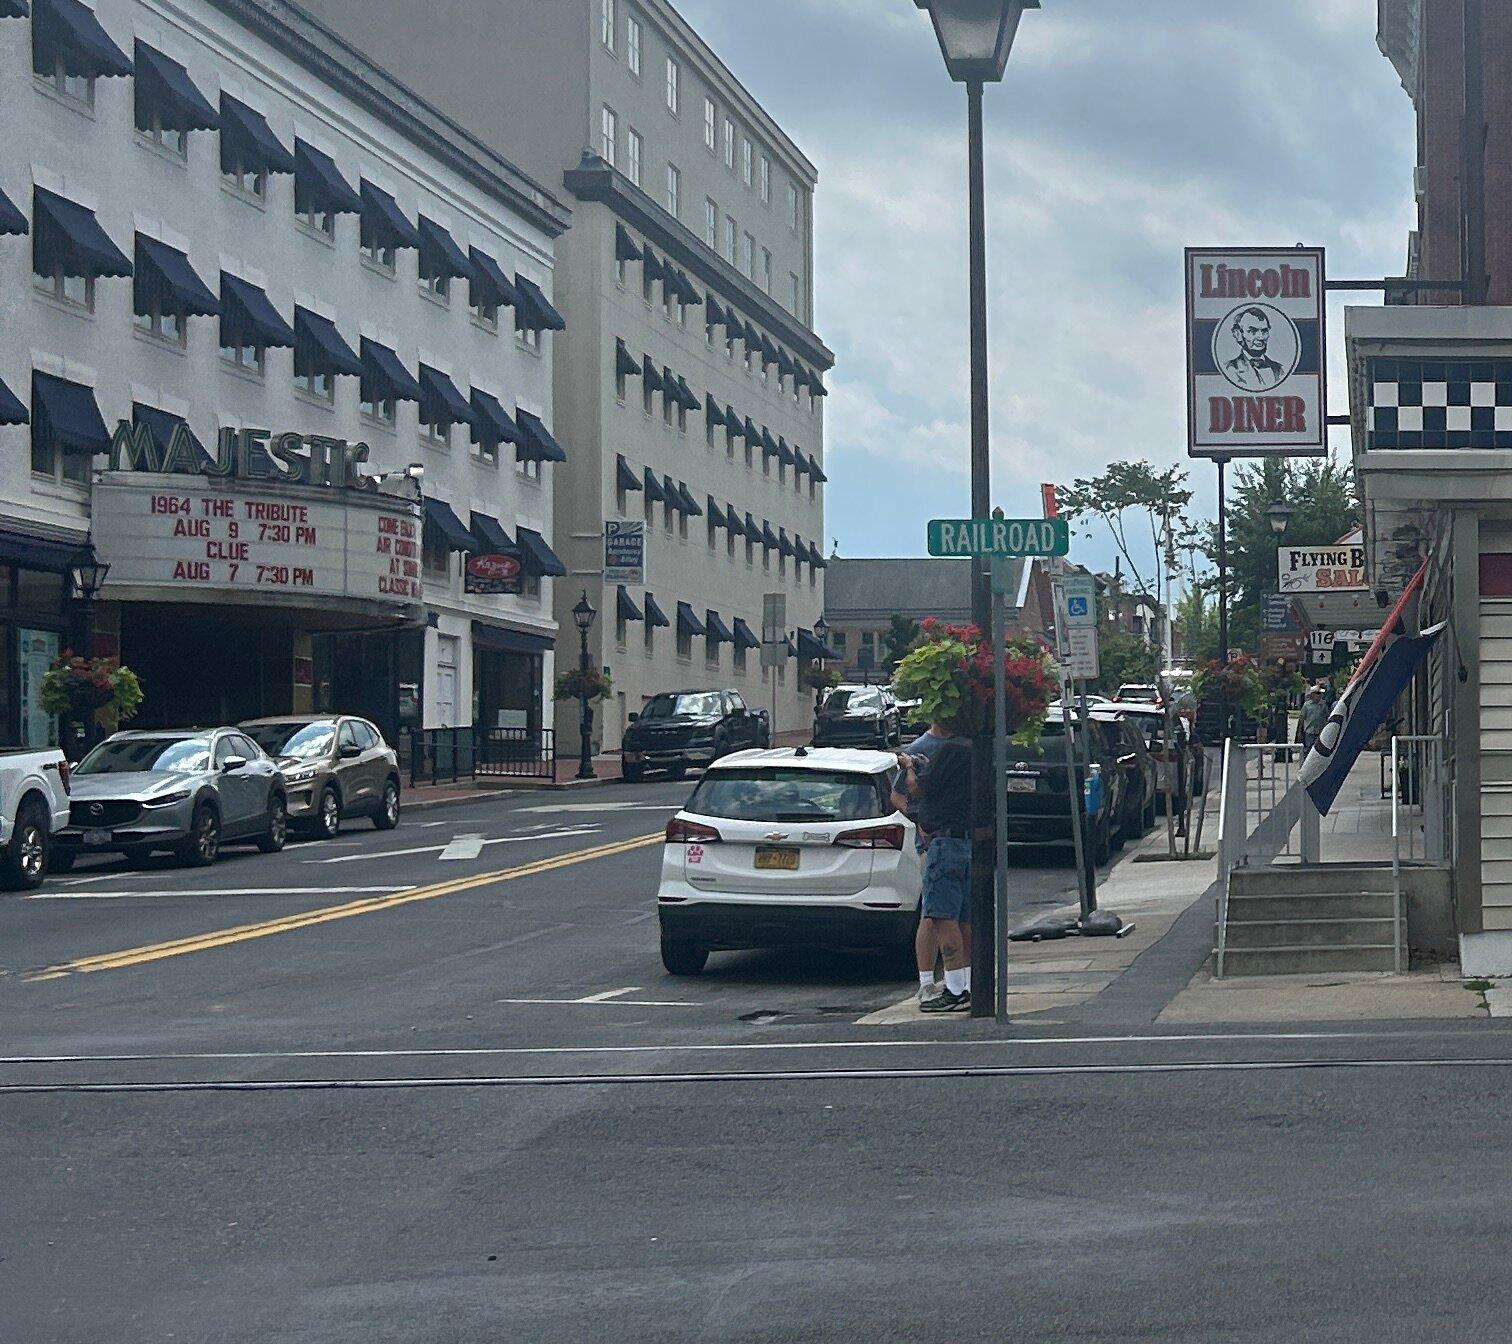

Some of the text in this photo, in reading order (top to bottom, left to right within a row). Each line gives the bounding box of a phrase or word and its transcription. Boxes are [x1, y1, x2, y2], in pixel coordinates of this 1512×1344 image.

[1200, 264, 1311, 298] Lincoln
[1209, 396, 1306, 433] DINER
[109, 419, 377, 491] MAJESTIC
[151, 495, 308, 523] 1964 THE TRIBUTE
[173, 518, 316, 545] AUG 9 7:30 PM
[941, 522, 1056, 552] RAILROAD
[206, 541, 249, 561] CLUE
[1289, 549, 1348, 572] FLYING
[172, 560, 314, 586] AUG 7 7:30 PM
[1311, 632, 1334, 645] 116
